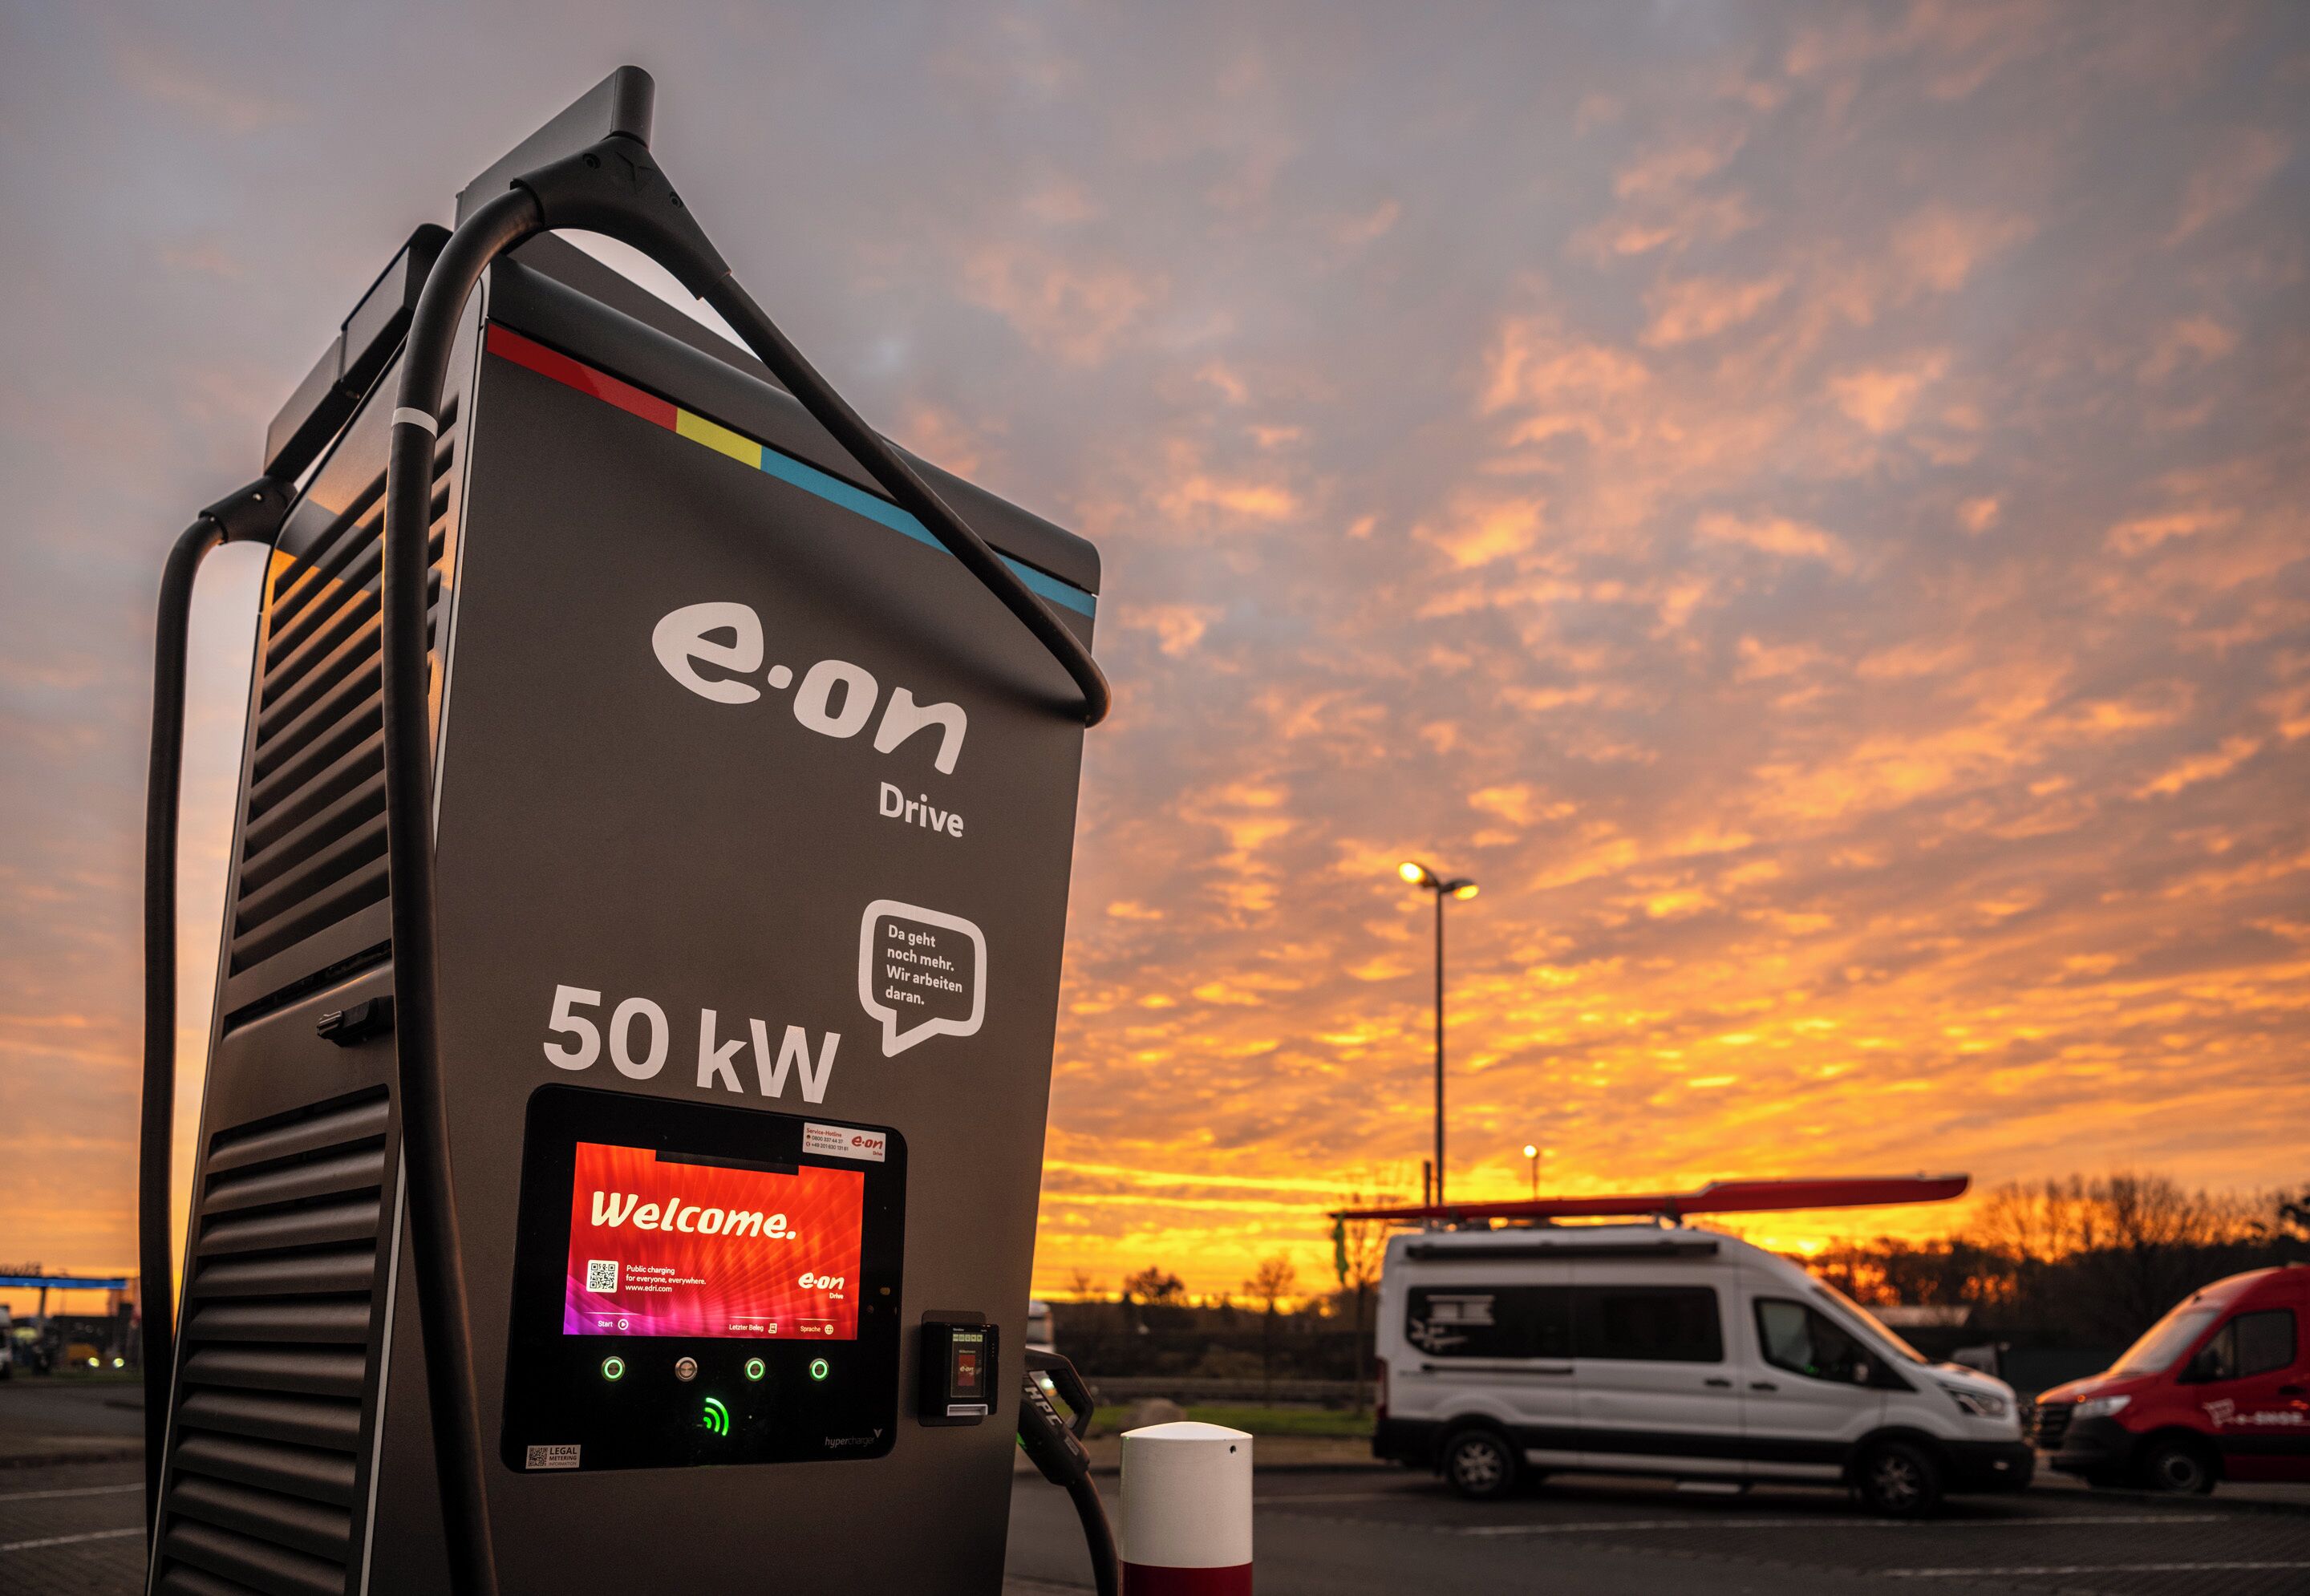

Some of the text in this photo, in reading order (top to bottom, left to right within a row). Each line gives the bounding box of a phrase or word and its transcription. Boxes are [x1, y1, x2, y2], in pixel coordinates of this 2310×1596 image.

[879, 781, 964, 837] Drive
[888, 924, 936, 947] Da geht
[887, 947, 954, 971] noch mehr.
[886, 964, 962, 993] Wir arbeiten
[886, 985, 925, 1005] daran.
[543, 983, 841, 1104] 50 kW
[806, 1128, 842, 1137] Service-Hotline
[591, 1191, 796, 1240] Welcome.
[626, 1265, 675, 1276] Public charging
[626, 1274, 707, 1286] for everyone, everywhere.
[748, 1324, 764, 1332] Beleg
[549, 1447, 578, 1455] LEGAL
[825, 1436, 875, 1448] hypercharger
